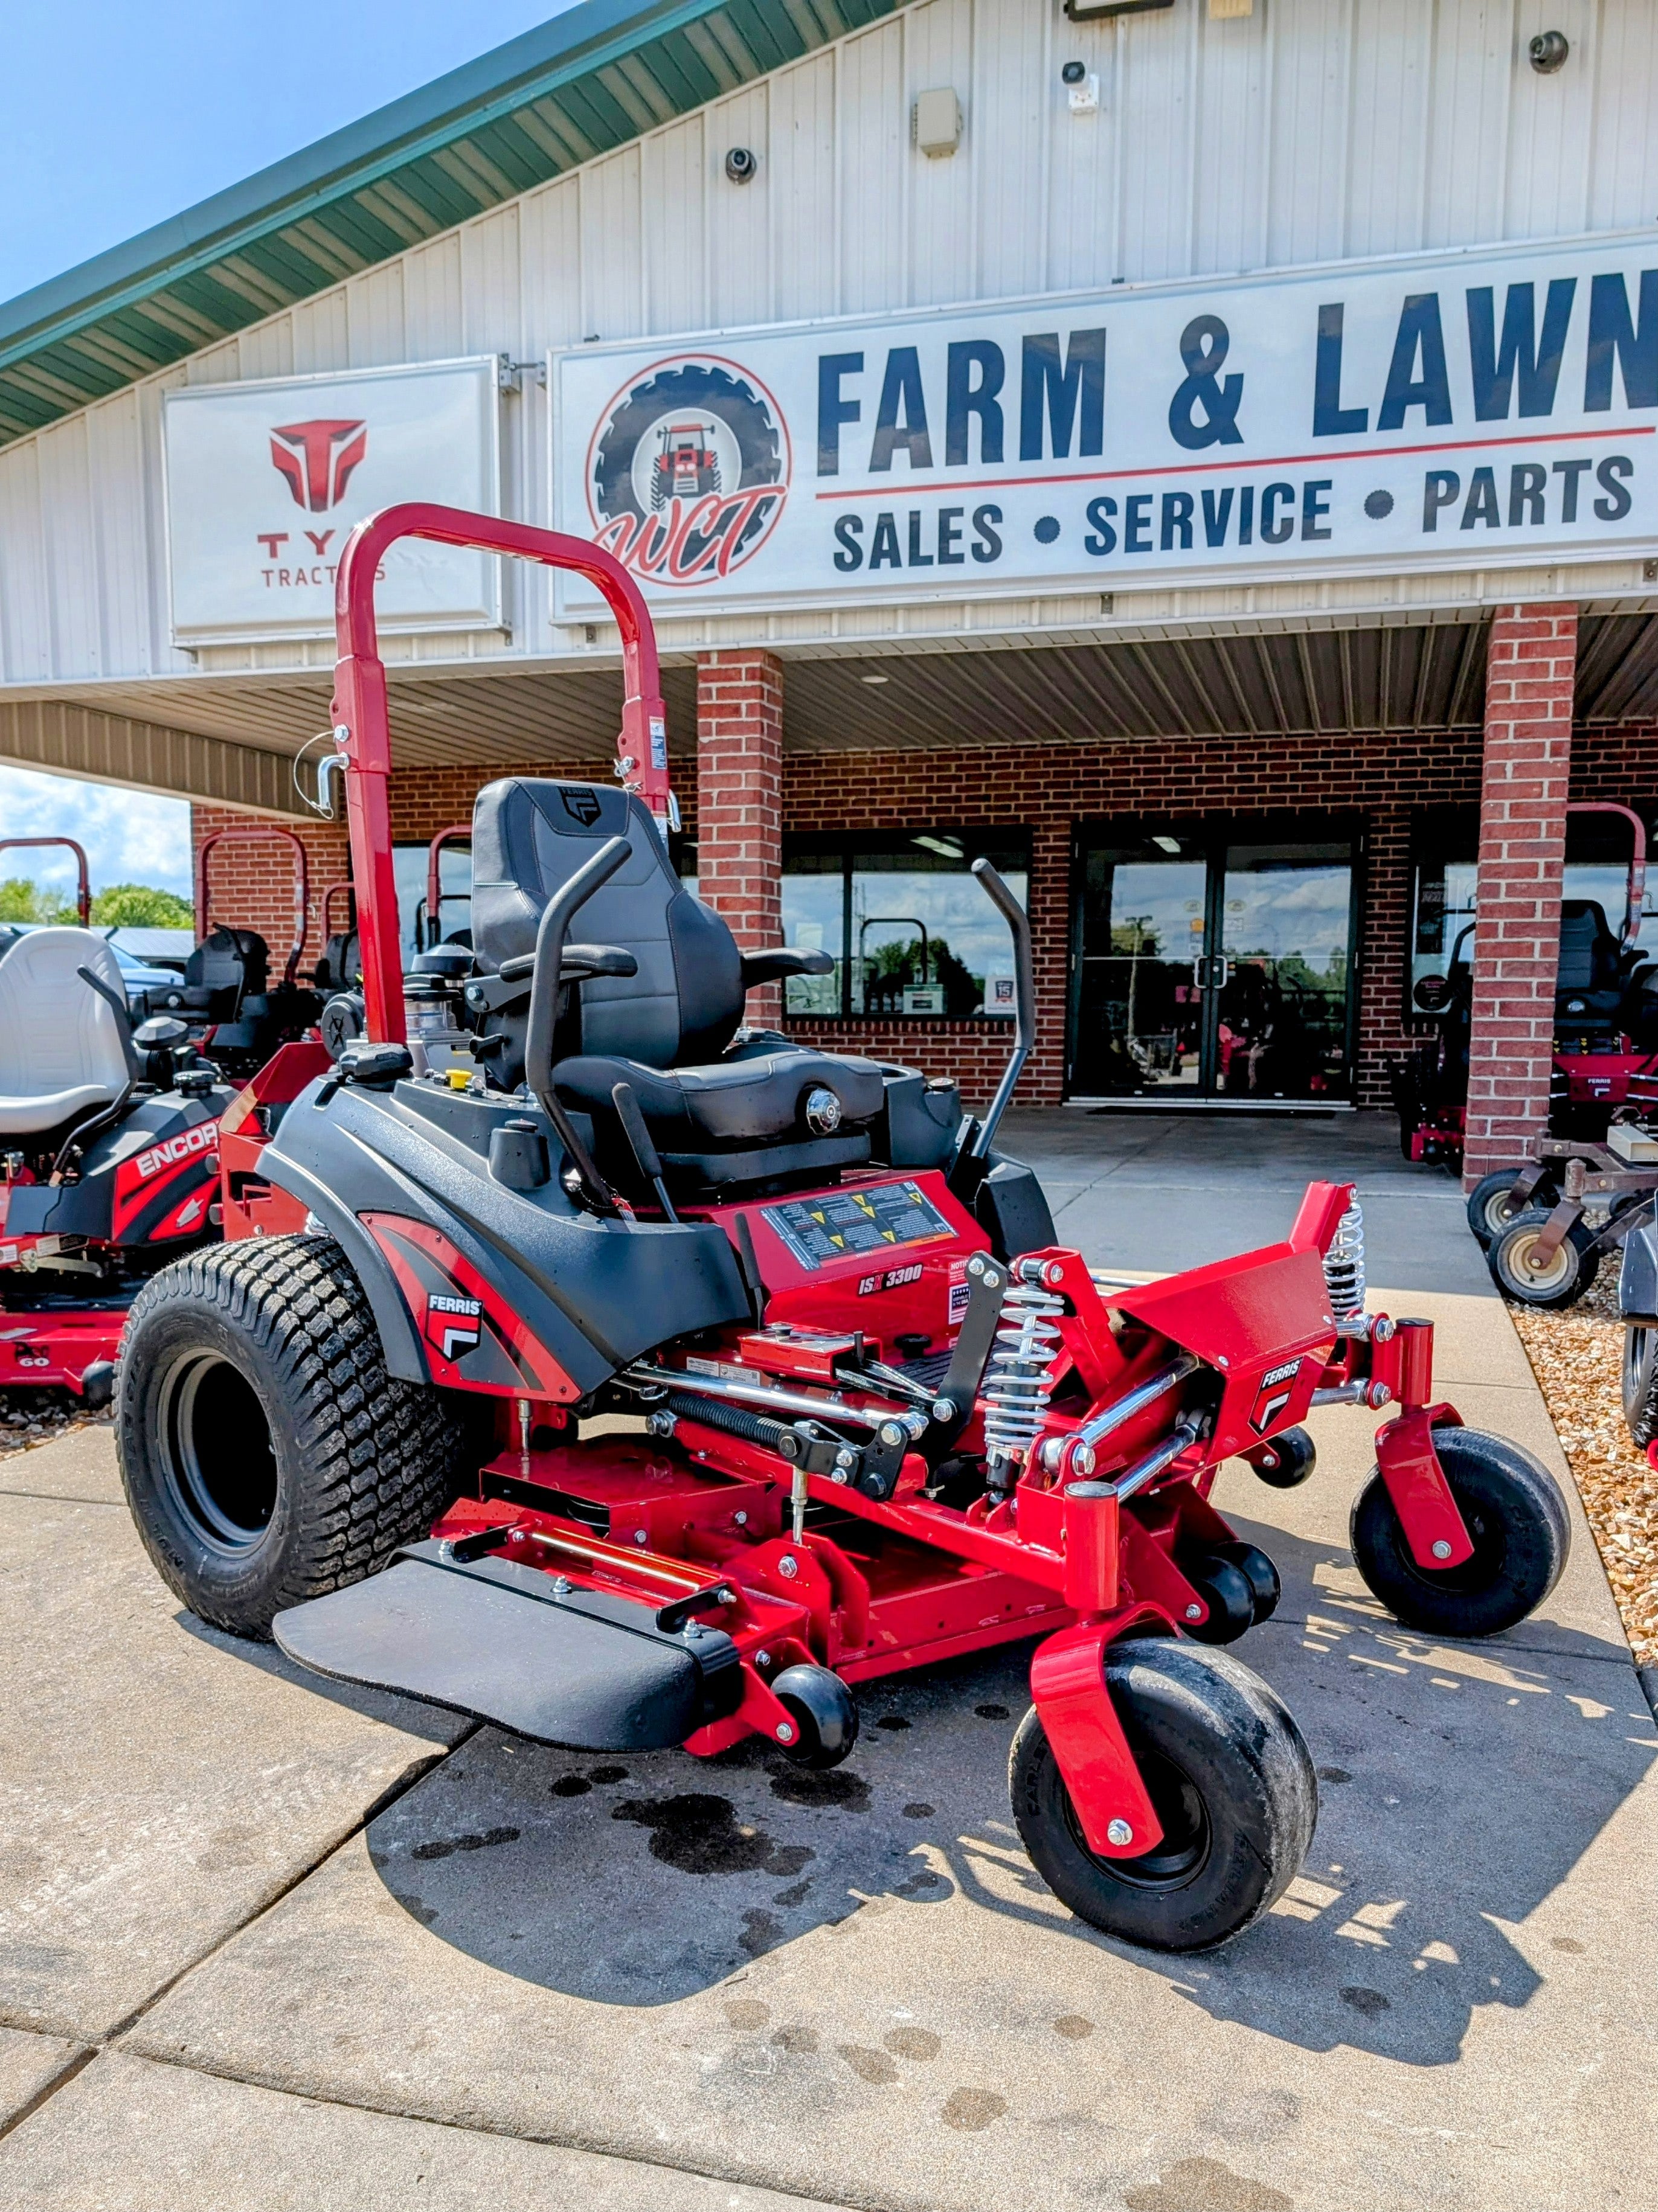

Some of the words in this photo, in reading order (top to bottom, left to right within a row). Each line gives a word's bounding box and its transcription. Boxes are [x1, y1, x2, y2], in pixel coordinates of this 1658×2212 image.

[817, 328, 1106, 476] FARM
[1168, 314, 1244, 450] &
[1313, 269, 1658, 437] LAWN
[834, 504, 1003, 572] SALES
[1084, 479, 1333, 556] SERVICE
[1422, 456, 1634, 533] PARTS
[257, 528, 356, 559] TY
[261, 563, 386, 587] TRACTS
[136, 1122, 219, 1178] ENCOR
[886, 1264, 923, 1287] 3300
[951, 1260, 969, 1271] NOTIC
[429, 1295, 480, 1315] FERRIS
[19, 1358, 50, 1367] 60
[1262, 1360, 1300, 1388] FERRIS
